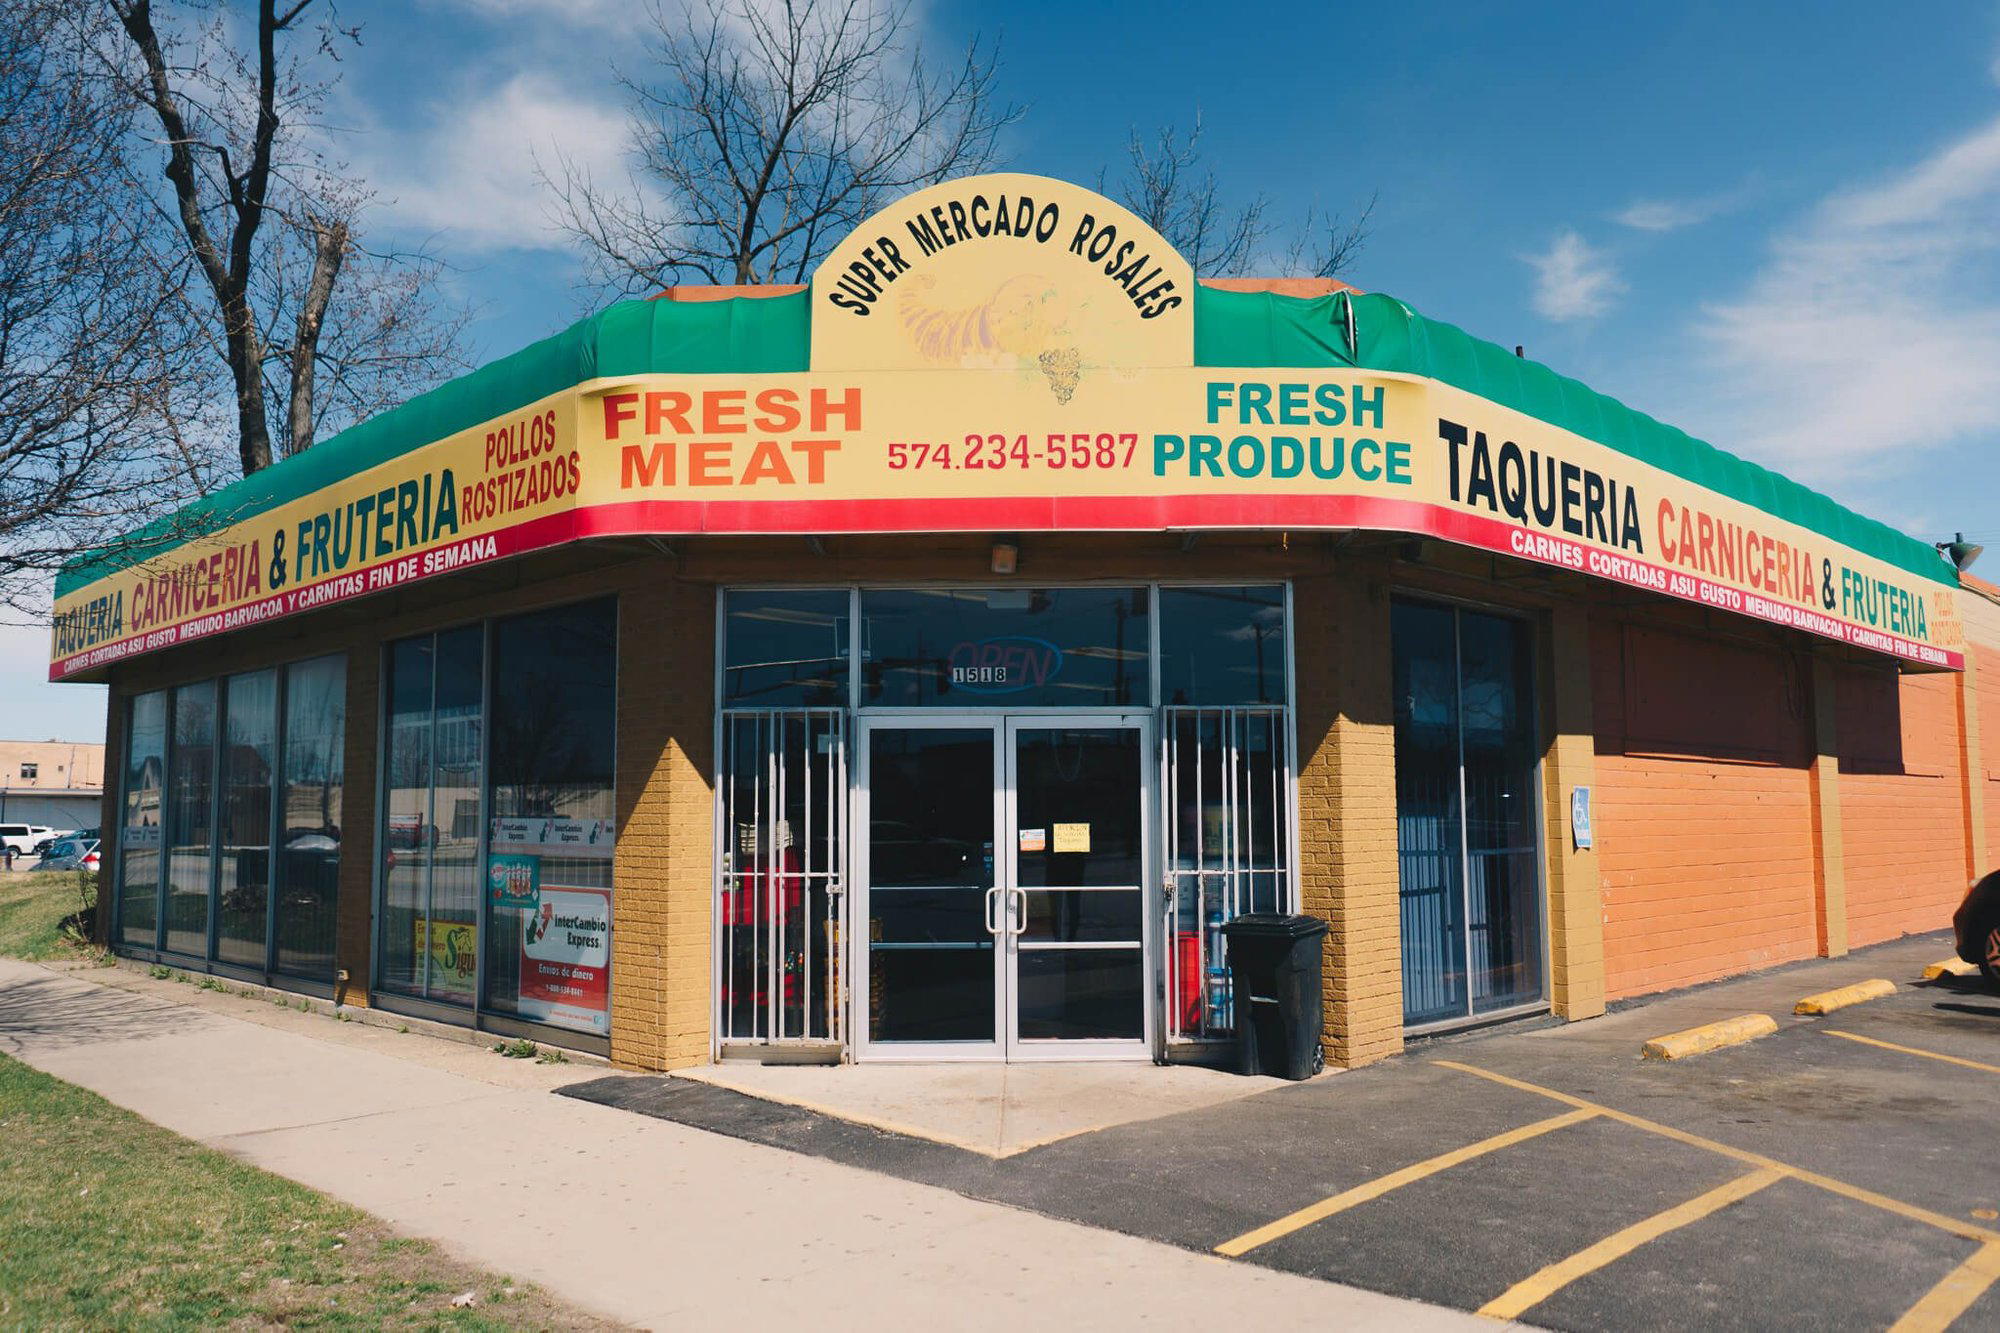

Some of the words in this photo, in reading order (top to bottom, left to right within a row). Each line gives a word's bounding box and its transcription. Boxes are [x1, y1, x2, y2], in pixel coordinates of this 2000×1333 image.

[829, 236, 912, 316] SUPER
[906, 194, 1060, 258] MERCADO
[1069, 213, 1182, 319] ROSALES
[604, 388, 862, 440] FRESH
[1206, 382, 1384, 429] FRESH
[485, 410, 556, 473] POLLOS
[620, 440, 841, 489] MEAT
[888, 433, 1138, 470] 574.234-5587
[1153, 434, 1412, 485] PRODUCE
[462, 451, 580, 525] ROSTIZADOS
[1438, 418, 1644, 555] TAQUERIA
[1657, 498, 1817, 606] CARNICERIA
[1821, 557, 1836, 610] &
[1842, 566, 1928, 641] FRUTERIA
[53, 590, 123, 659] TAQUERIA
[131, 539, 260, 632] CARNICERIA
[269, 529, 287, 590] &
[295, 468, 458, 583] FRUTERIA
[64, 655, 88, 673] CARNES
[90, 644, 127, 665] CORTADAS
[146, 629, 176, 649] GUSTO
[180, 613, 223, 639] MENUDO
[225, 602, 283, 629] BARVACOA
[288, 594, 297, 611] Y
[299, 573, 364, 608] CARNITAS
[369, 565, 394, 590] FIN
[397, 557, 418, 582] DE
[423, 536, 497, 574] SEMANA
[1511, 530, 1584, 568] CARNES
[1589, 552, 1667, 590] CORTADAS
[1700, 581, 1741, 609] GUSTO
[1745, 594, 1792, 624] MENUDO
[1793, 609, 1844, 638] BARVACOA
[1844, 625, 1853, 640] Y
[1853, 628, 1893, 652] CARNITAS
[1894, 639, 1908, 656] FIN
[1908, 643, 1919, 658] DE
[1919, 646, 1948, 664] SEMANA
[947, 641, 1051, 687] OPEN
[953, 667, 1006, 682] 1518
[555, 914, 607, 931] InterCambio
[572, 968, 594, 981] dinero
